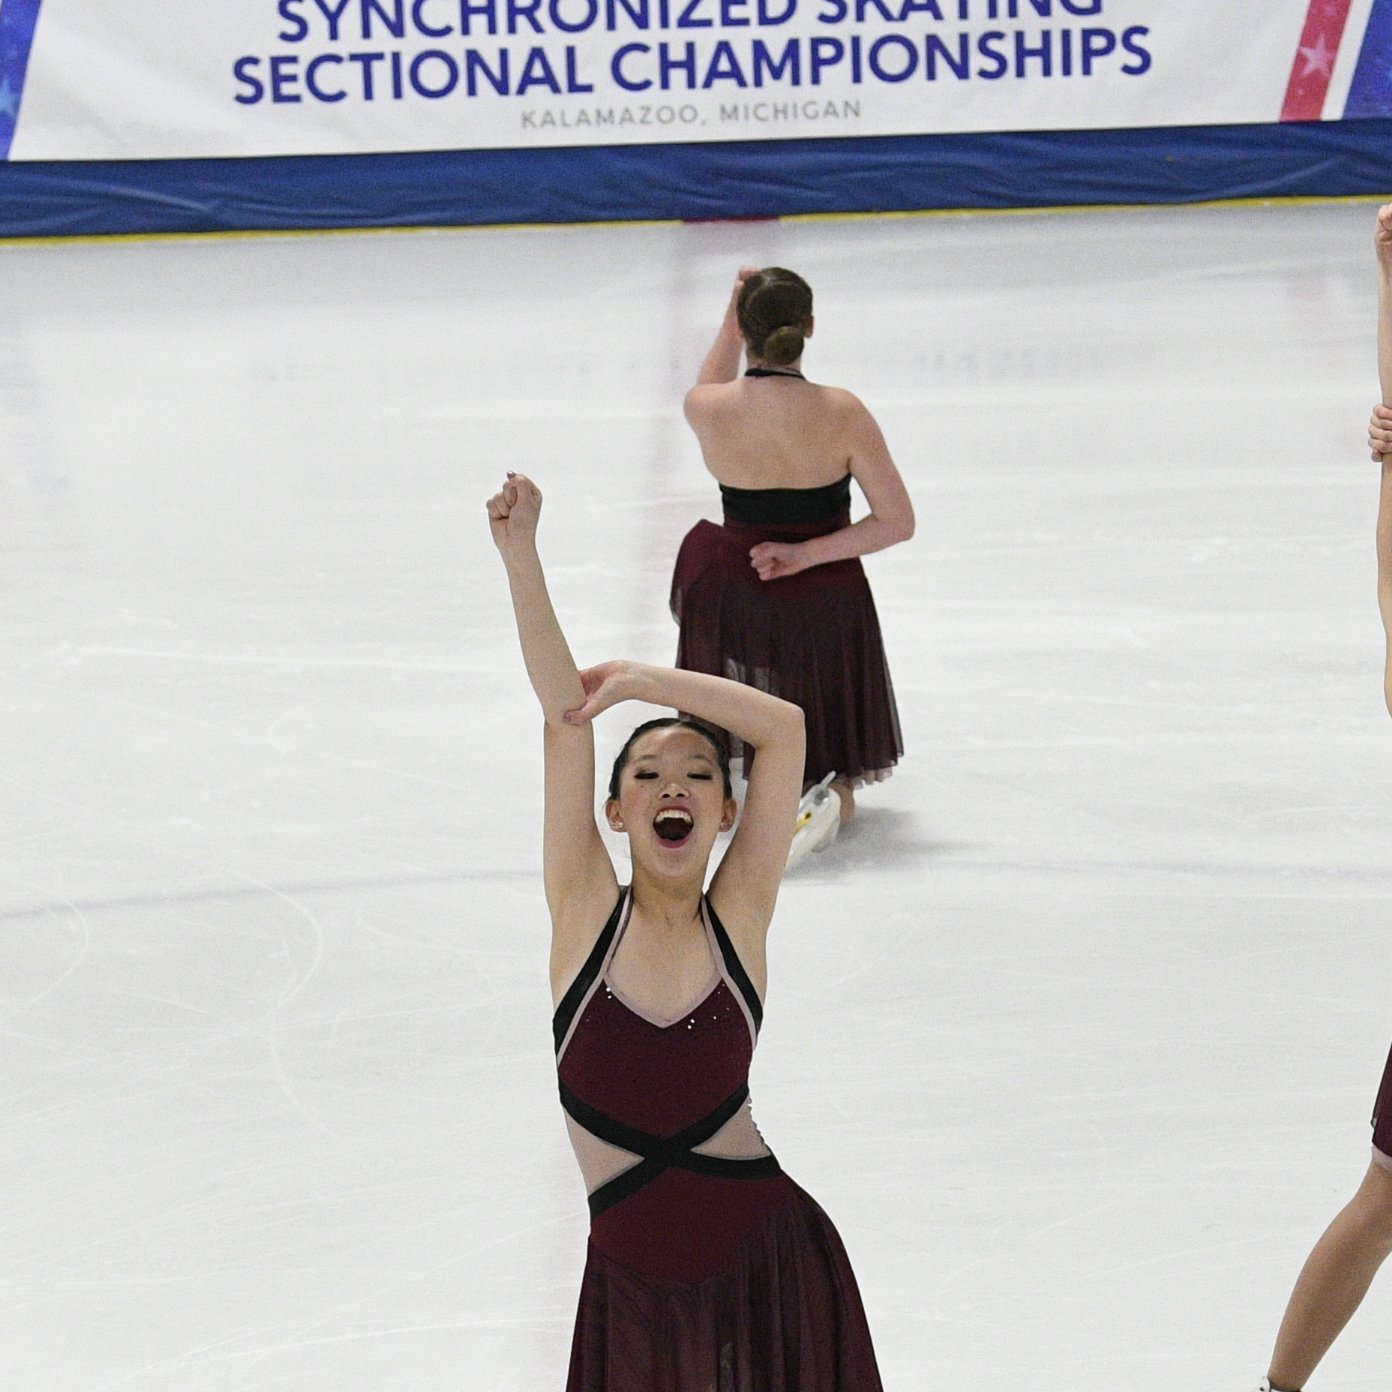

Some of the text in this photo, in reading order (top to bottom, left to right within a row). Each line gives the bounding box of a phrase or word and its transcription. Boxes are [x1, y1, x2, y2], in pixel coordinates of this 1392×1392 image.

[233, 26, 1152, 104] SECTIONAL CHAMPIONSHIPS
[520, 99, 861, 129] KALAMAZOO, MICHIGAN
